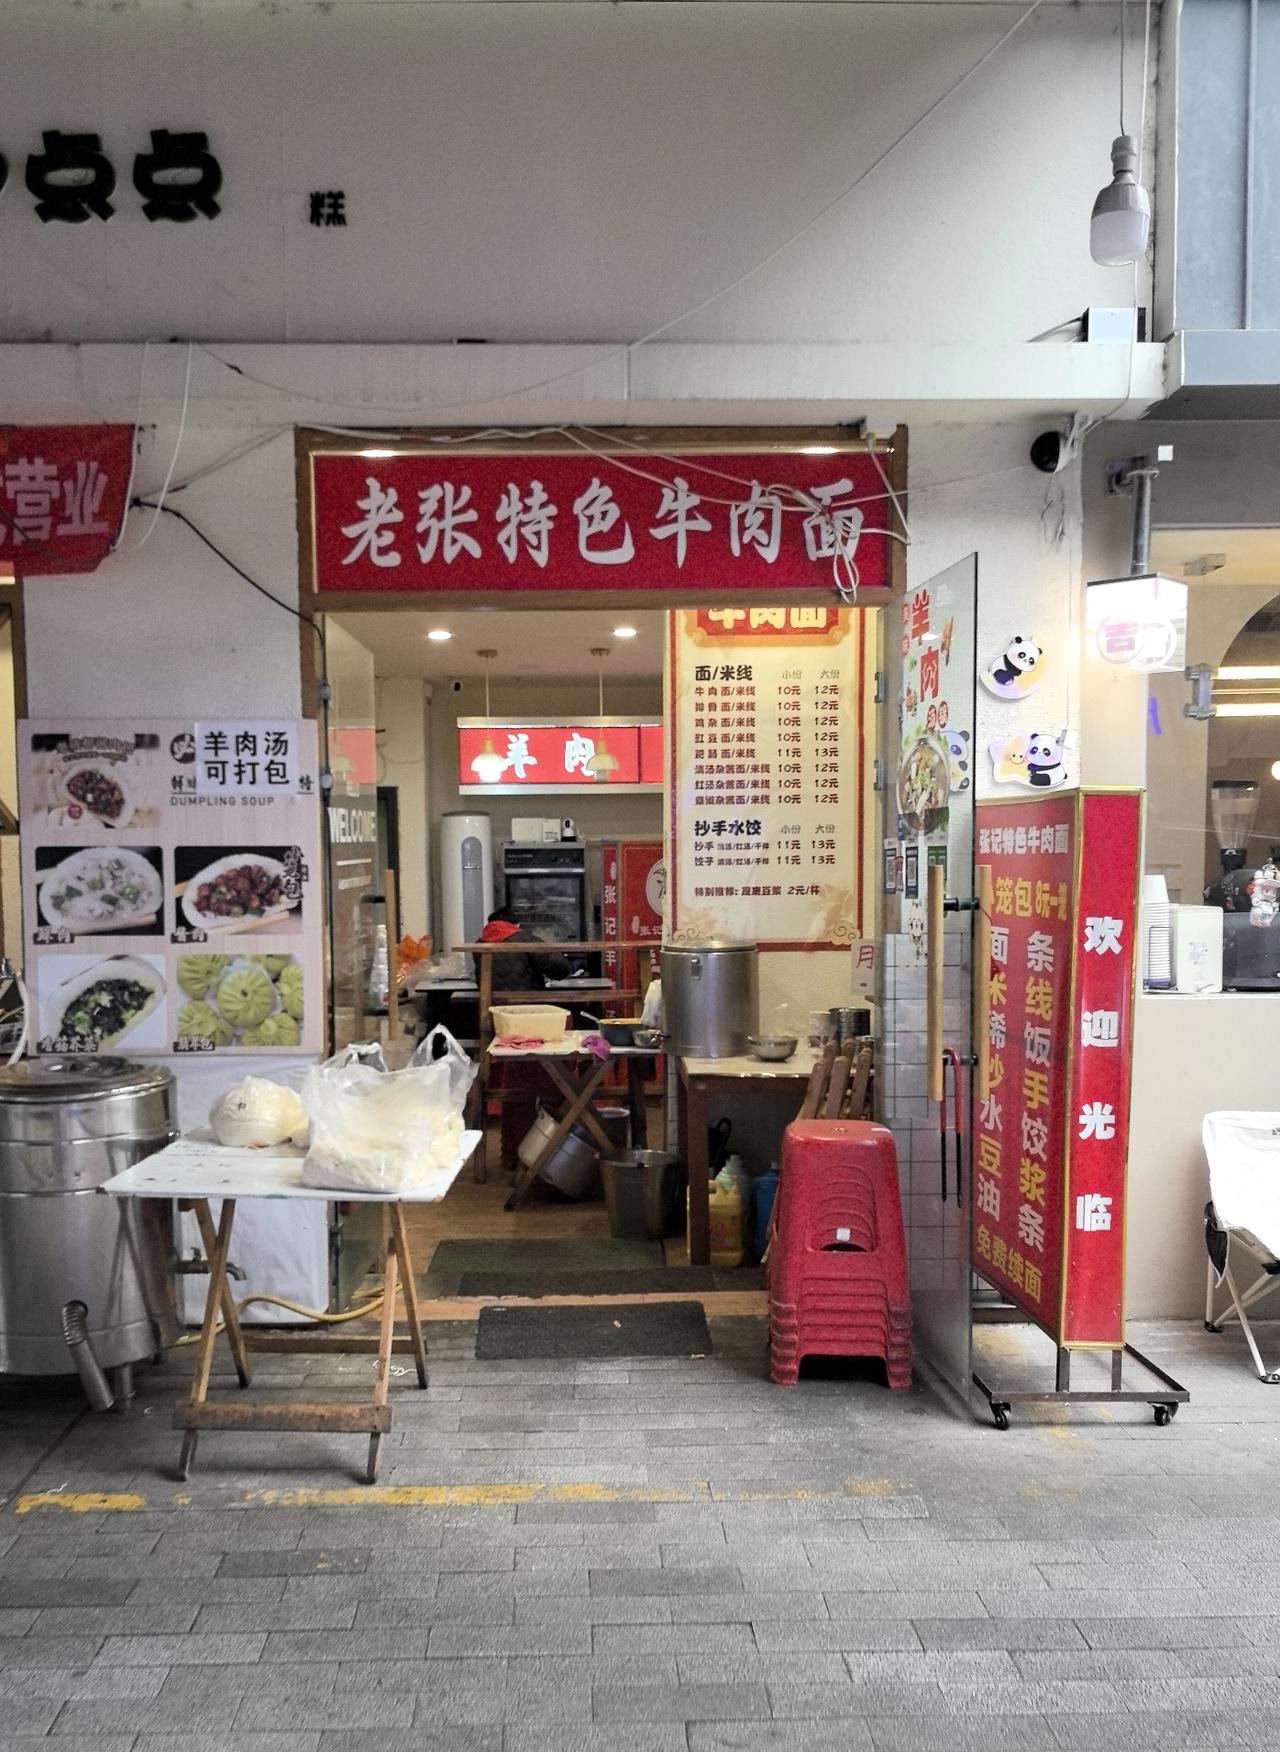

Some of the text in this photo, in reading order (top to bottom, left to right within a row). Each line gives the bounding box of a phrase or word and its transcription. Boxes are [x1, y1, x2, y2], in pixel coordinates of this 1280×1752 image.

[0, 129, 222, 223] 点点
[0, 456, 109, 545] 营业
[341, 476, 867, 567] 老张特色牛肉面
[695, 665, 753, 681] 面/米线
[777, 685, 801, 695] 10元
[814, 685, 839, 695] 12元
[777, 701, 801, 711] 10元
[814, 701, 839, 711] 12元
[777, 717, 801, 727] 10元
[814, 716, 839, 726] 12元
[777, 733, 801, 743] 10元
[814, 732, 839, 742] 12元
[204, 730, 290, 757] 羊肉汤
[777, 748, 801, 758] 11元
[814, 748, 839, 757] 13元
[204, 759, 290, 786] 可打包
[777, 763, 801, 773] 10元
[814, 763, 839, 773] 12元
[777, 779, 801, 788] 10元
[814, 778, 839, 788] 12元
[170, 796, 275, 806] DUMPLING SOUP
[777, 794, 801, 804] 10元
[814, 794, 839, 804] 12元
[694, 820, 762, 836] 抄手水饺
[777, 840, 801, 850] 11元
[811, 840, 836, 850] 13元
[777, 856, 801, 866] 11元
[811, 855, 836, 865] 13元
[991, 876, 1033, 917] 笼包
[1075, 915, 1124, 1232] 欢迎光临
